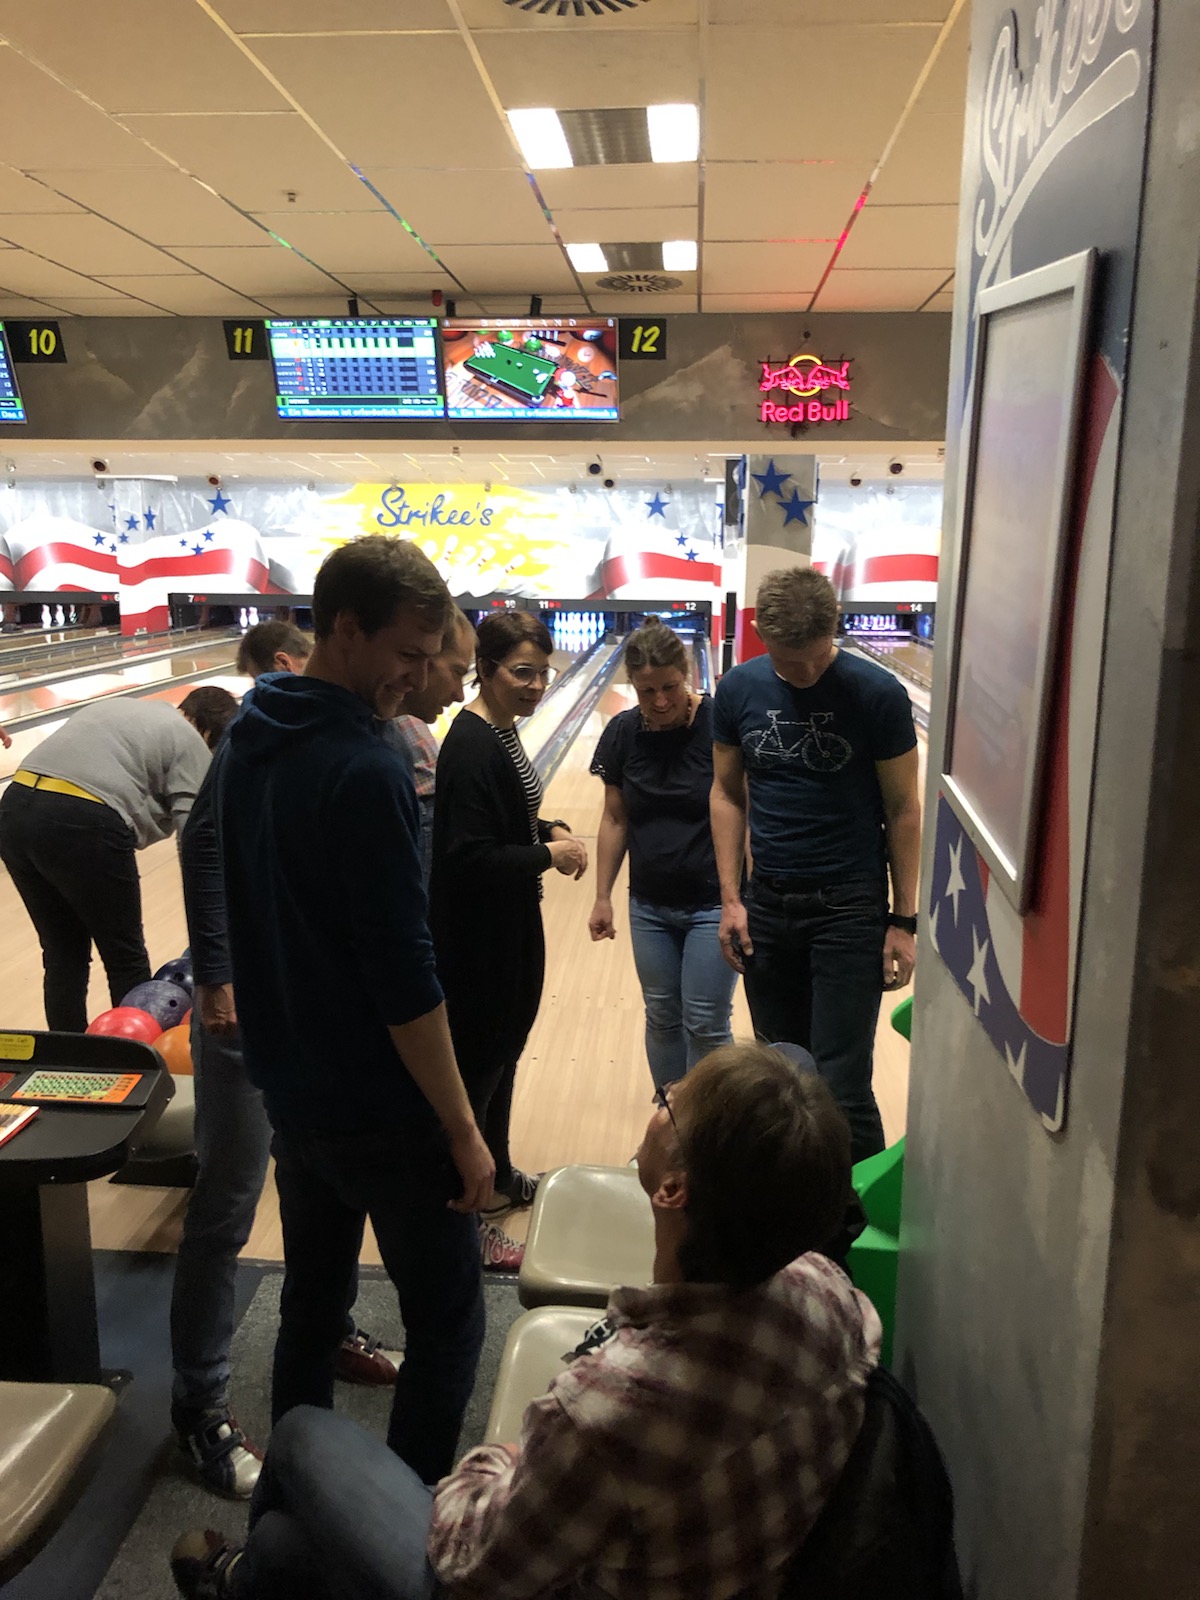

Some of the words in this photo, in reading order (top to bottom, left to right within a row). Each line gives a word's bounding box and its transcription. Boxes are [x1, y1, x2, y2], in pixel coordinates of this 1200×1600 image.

[29, 328, 56, 356] 10
[233, 327, 253, 354] 11
[631, 325, 660, 353] 12
[761, 401, 804, 422] Red
[807, 400, 848, 422] Bull
[376, 486, 494, 527] Strikee's
[188, 595, 194, 603] 7
[539, 600, 549, 609] 11
[685, 602, 697, 611] 12
[910, 603, 923, 612] 14
